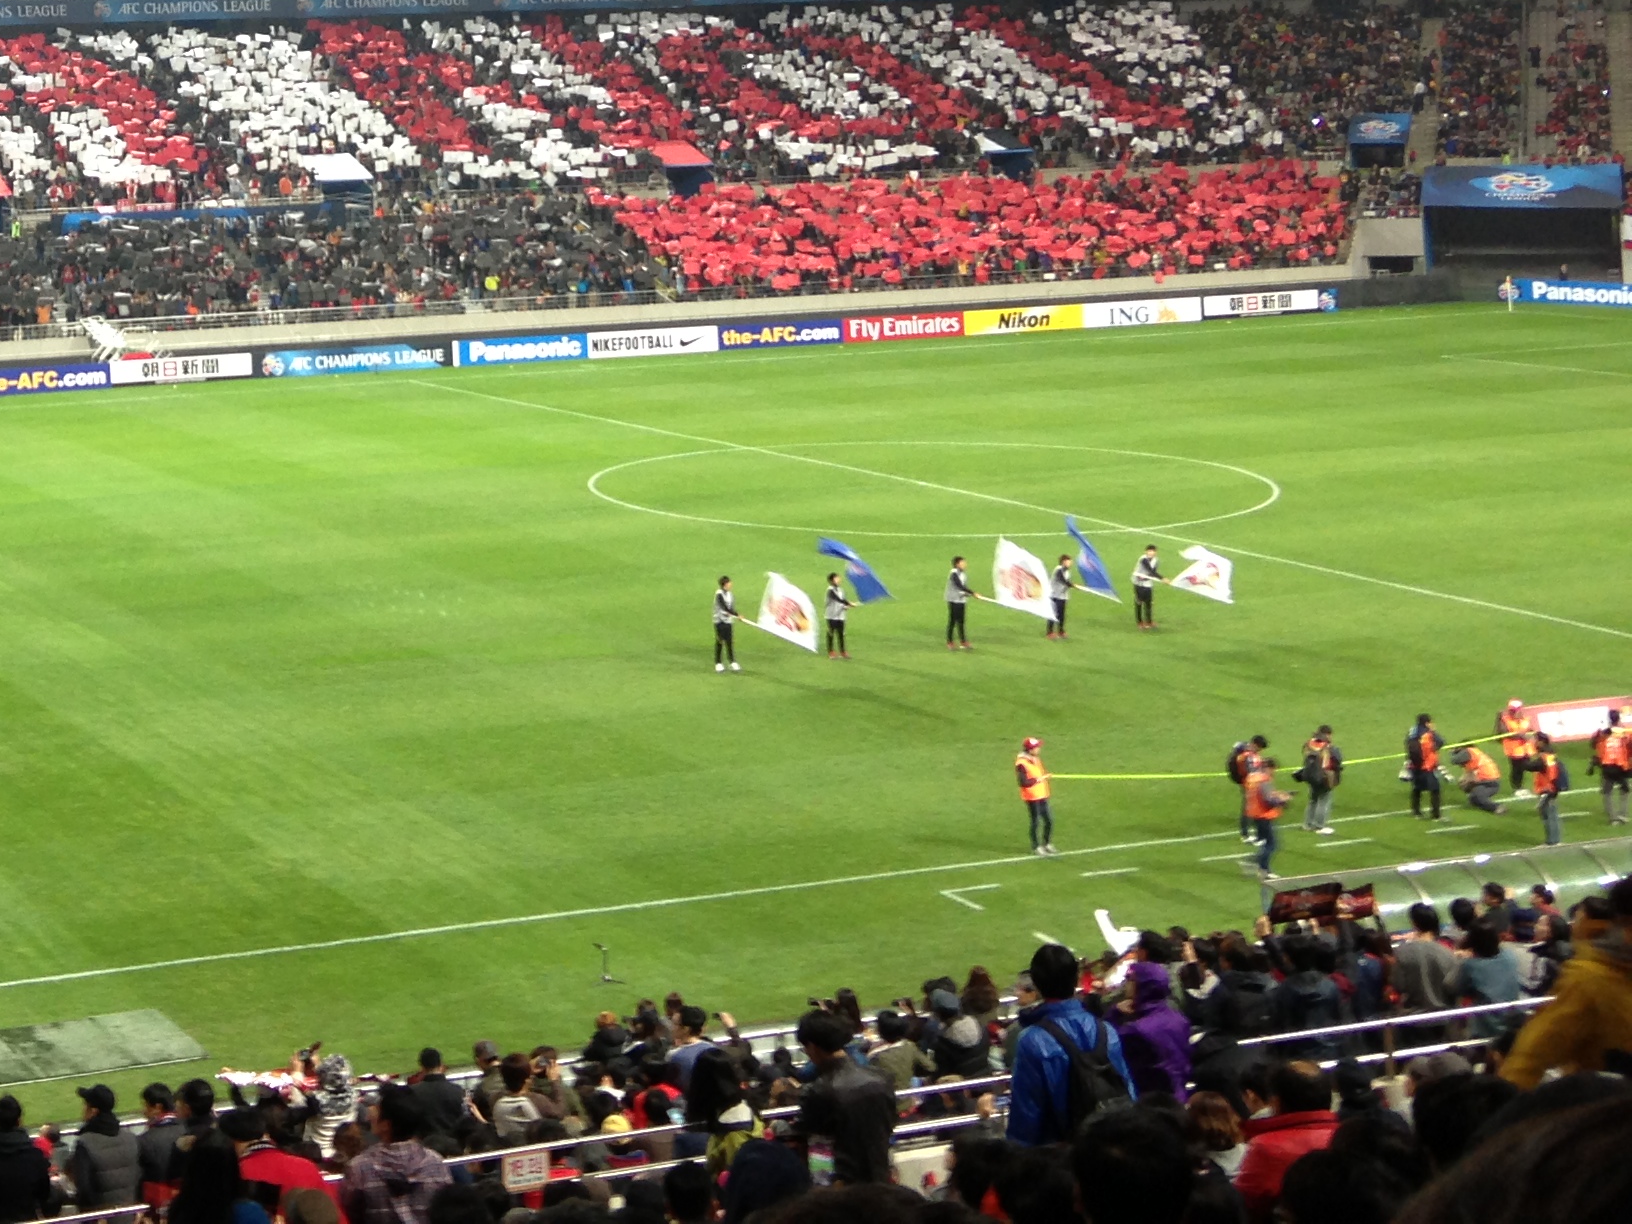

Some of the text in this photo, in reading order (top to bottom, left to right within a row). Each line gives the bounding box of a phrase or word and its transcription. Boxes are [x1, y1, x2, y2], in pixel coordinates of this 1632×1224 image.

[18, 3, 68, 18] LEAGUE
[118, 3, 141, 16] AFC
[144, 0, 219, 16] CHAMPIONS
[997, 312, 1050, 329] Nikon
[1109, 306, 1150, 326] ING
[722, 325, 839, 345] the-AFC.com
[849, 314, 960, 341] Fly Emirates
[469, 336, 582, 362] Panasonic
[592, 327, 672, 352] NIKEFOOTBALL
[289, 348, 445, 370] AFC CHAMPIONS LEAGUE
